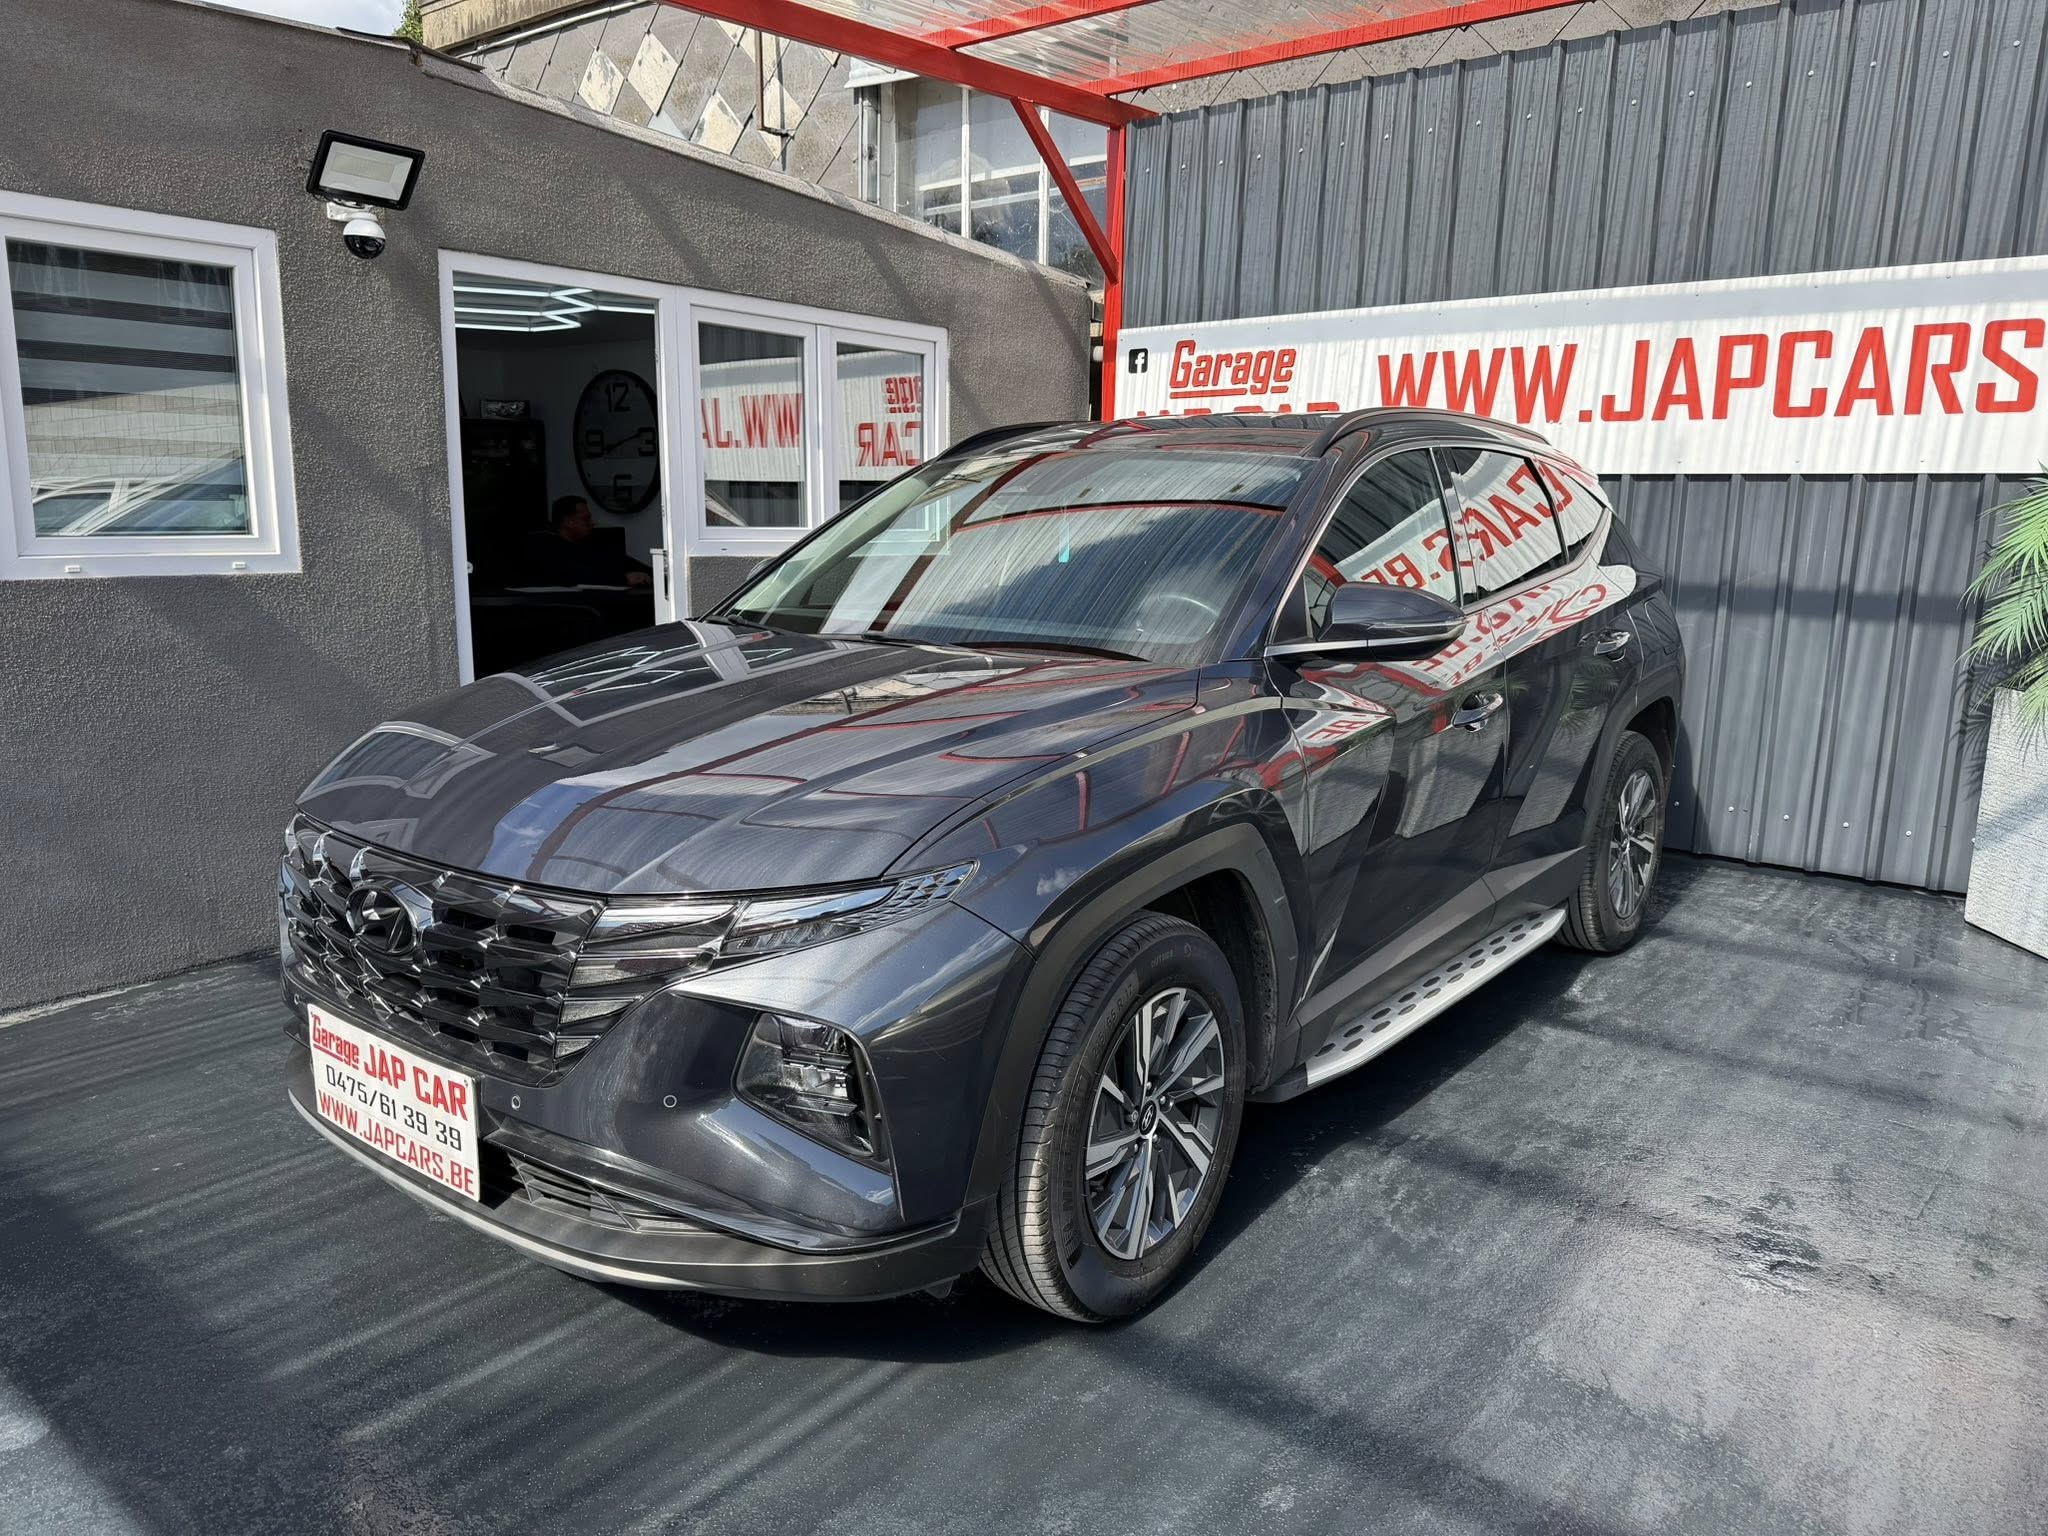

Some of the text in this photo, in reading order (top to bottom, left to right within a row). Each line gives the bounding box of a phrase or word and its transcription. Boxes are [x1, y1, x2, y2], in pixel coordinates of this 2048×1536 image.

[605, 382, 631, 413] 12
[1169, 339, 1297, 397] Garage
[1378, 318, 2046, 424] WWW.JAPCARS
[585, 427, 656, 457] 9 3
[312, 1014, 468, 1121] Garage JAP CAR
[326, 1064, 462, 1152] 0475/61 39 39
[318, 1089, 475, 1196] WWW.JAPCARS.BE
